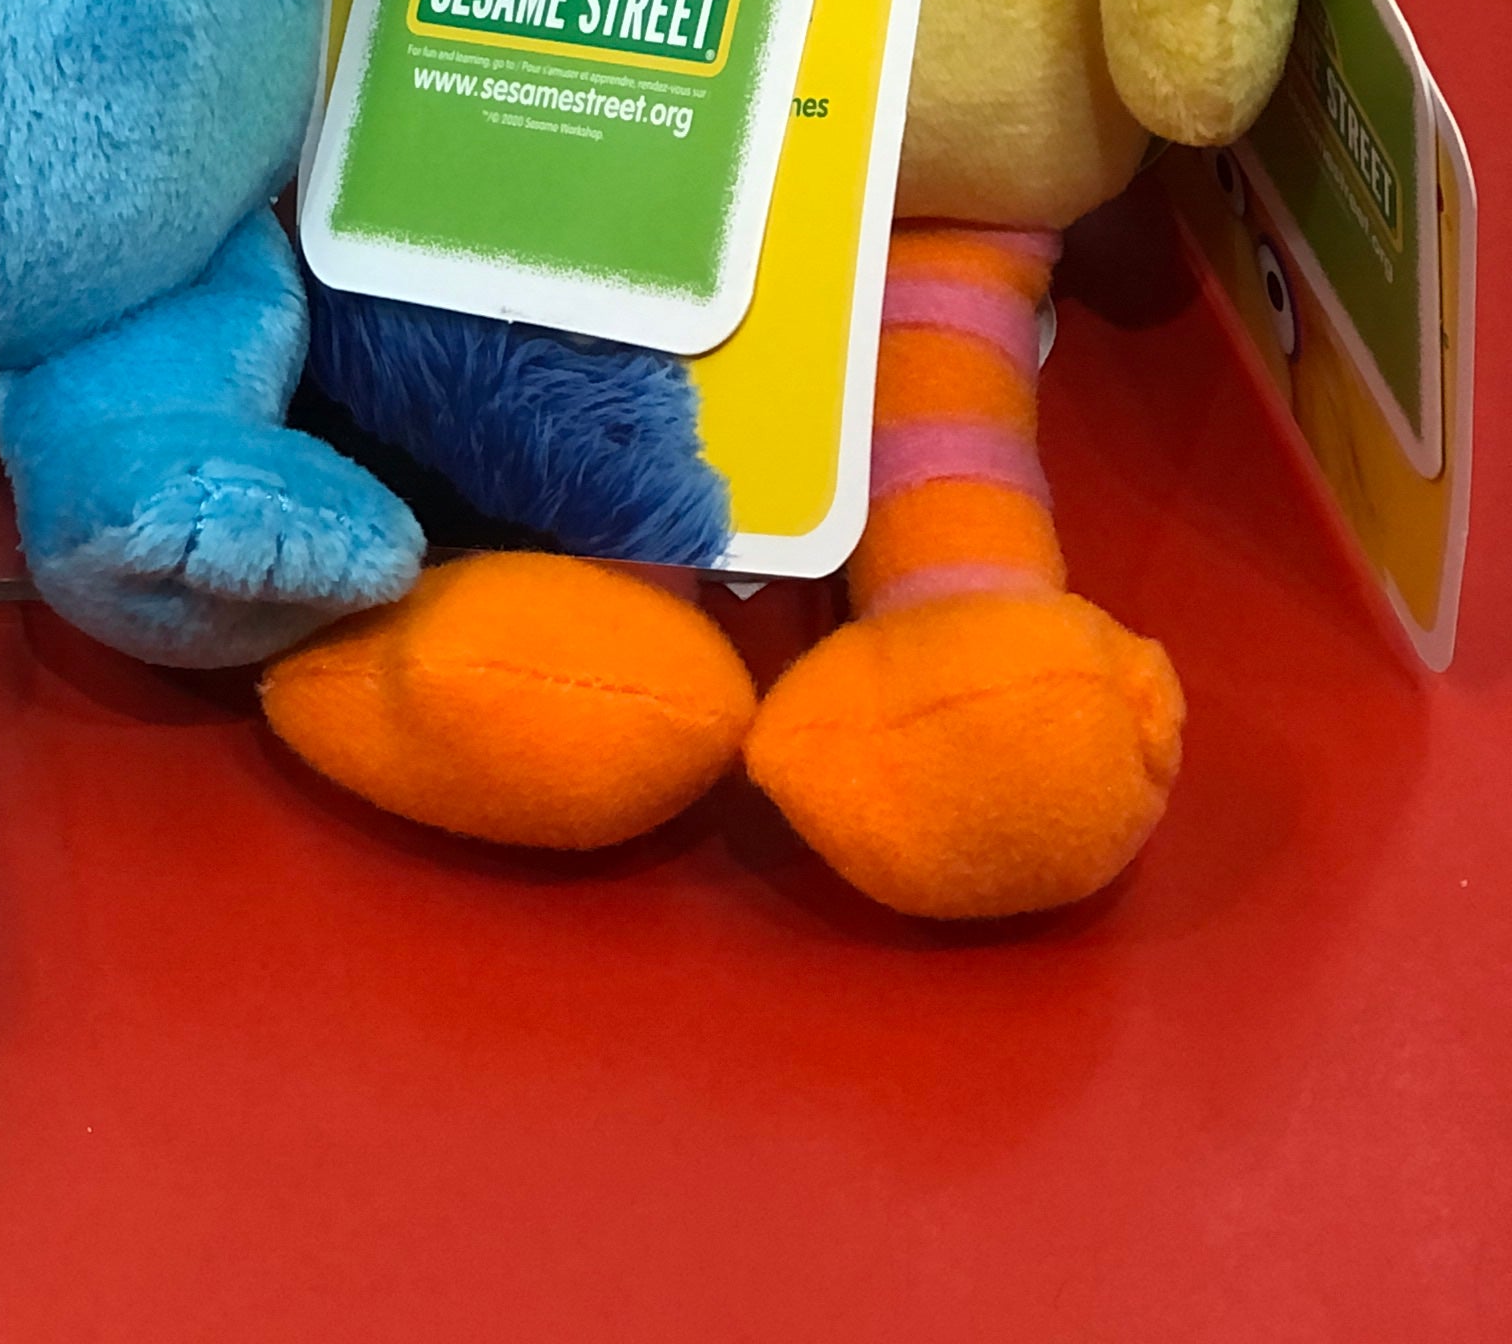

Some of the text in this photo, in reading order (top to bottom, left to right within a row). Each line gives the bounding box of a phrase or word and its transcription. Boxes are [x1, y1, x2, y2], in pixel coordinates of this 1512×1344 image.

[407, 43, 422, 55] For
[423, 45, 437, 58] fun
[438, 49, 455, 61] and
[492, 58, 505, 70] go
[521, 60, 541, 74] Pour
[414, 66, 694, 139] www.sesamestreet.org
[1326, 66, 1393, 218] STREET
